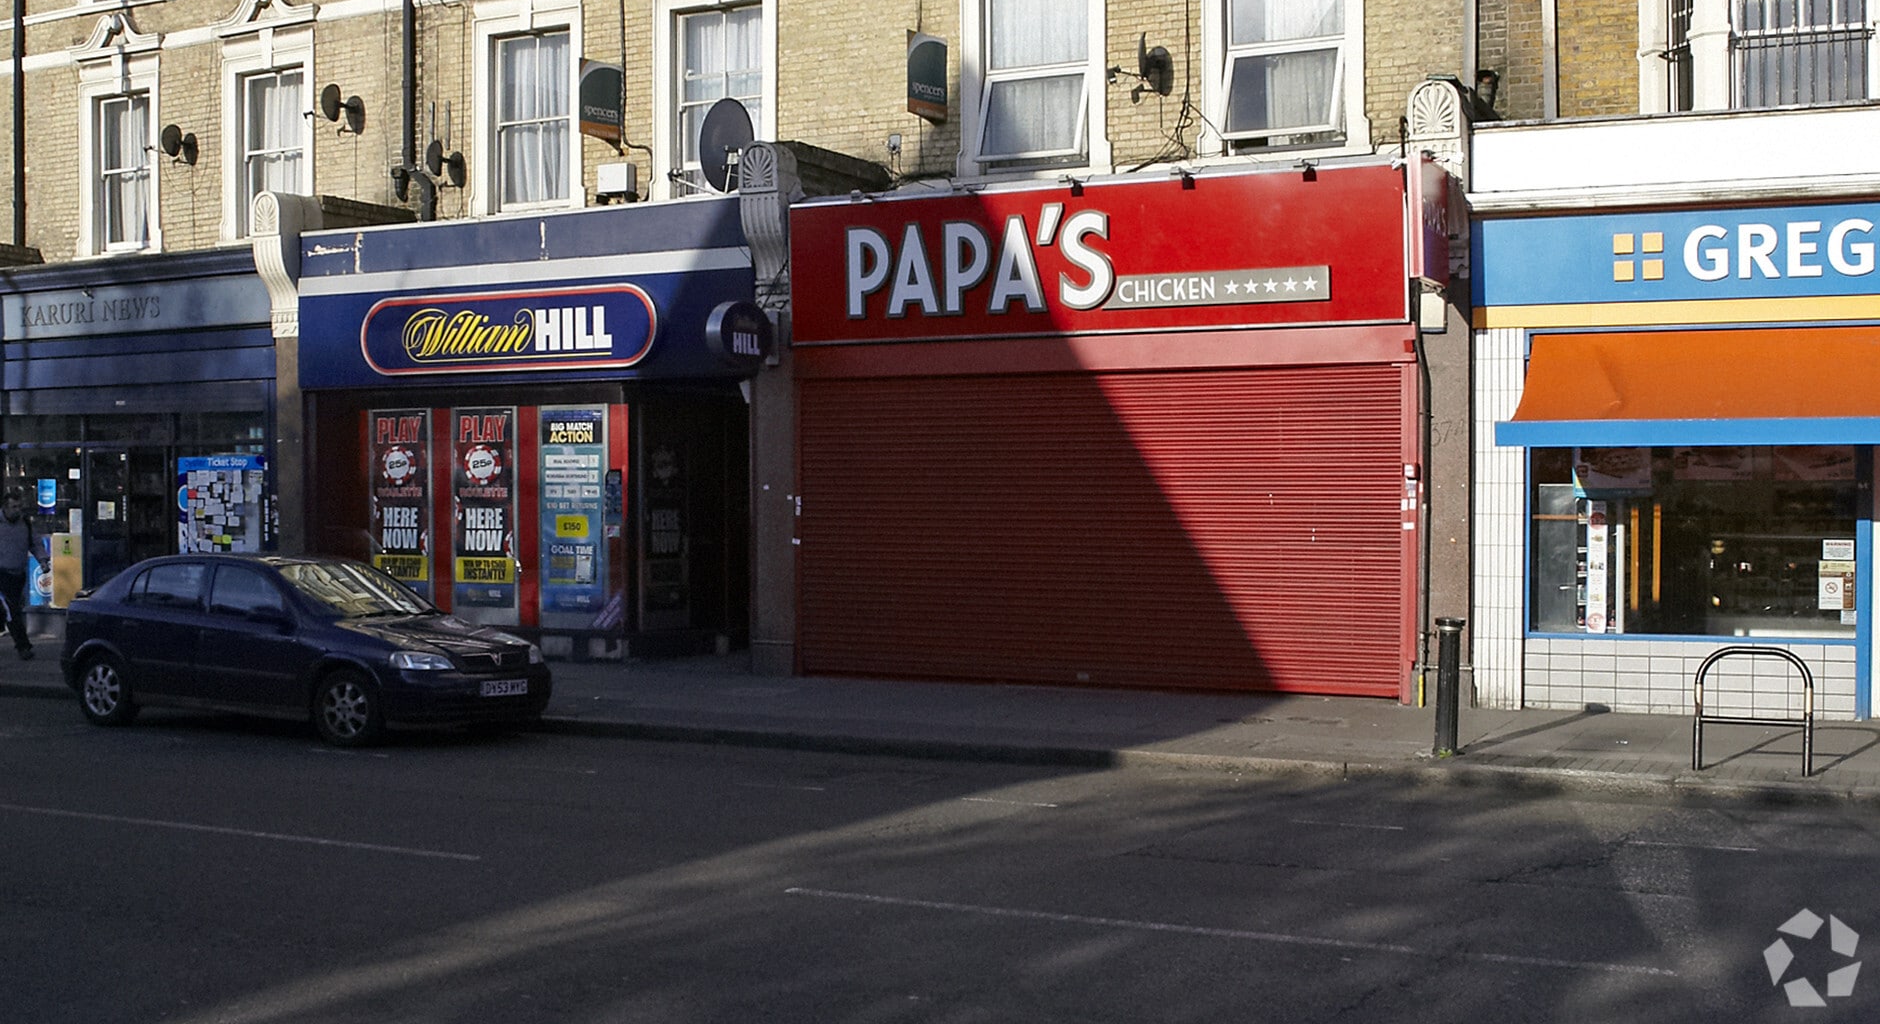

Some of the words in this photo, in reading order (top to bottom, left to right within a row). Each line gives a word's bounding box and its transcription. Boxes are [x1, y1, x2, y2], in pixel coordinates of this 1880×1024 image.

[912, 81, 945, 97] spencers
[584, 105, 618, 120] spencers
[846, 202, 1113, 319] PAPA'S
[1683, 219, 1876, 282] GREG
[1117, 276, 1216, 303] CHICKEN
[21, 301, 96, 327] KARURI
[103, 296, 161, 322] NEWS
[402, 308, 535, 357] William
[535, 306, 613, 351] HILL
[733, 331, 760, 355] HILL
[377, 416, 422, 444] PLAY
[460, 414, 507, 443] PLAY
[549, 431, 593, 443] ACTION
[550, 422, 565, 431] BIG
[566, 422, 593, 431] MATCH
[230, 457, 248, 468] Stop
[383, 507, 419, 527] HERE
[465, 507, 503, 529] HERE
[382, 528, 418, 549] NOW
[465, 529, 503, 551] NOW
[551, 545, 574, 554] GOAL
[575, 546, 593, 554] TIME
